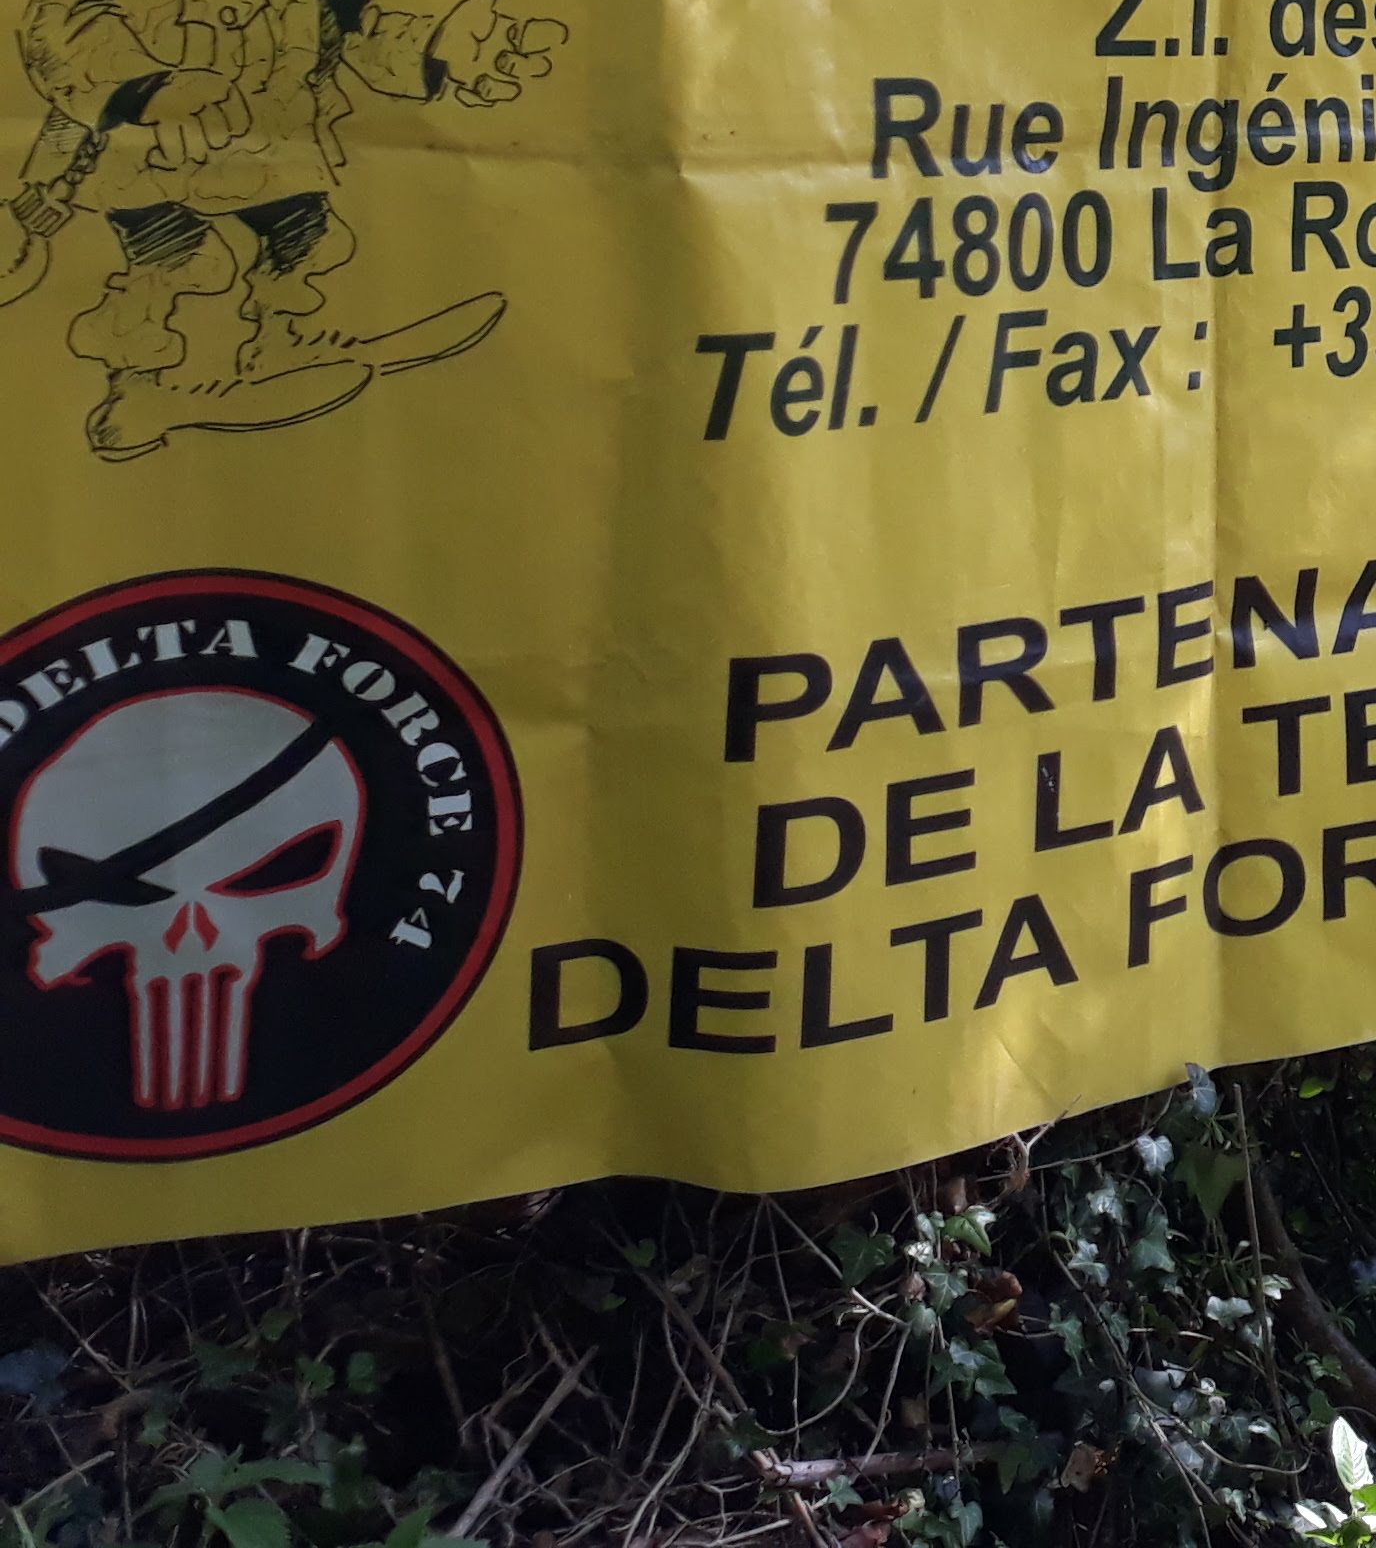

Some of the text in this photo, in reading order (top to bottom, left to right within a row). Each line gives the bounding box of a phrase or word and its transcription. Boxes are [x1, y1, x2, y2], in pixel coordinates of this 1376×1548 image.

[871, 78, 1063, 178] Rue
[826, 190, 1112, 304] 74800
[1152, 188, 1253, 280] La
[694, 325, 877, 442] Tél.
[985, 309, 1161, 413] Fax
[288, 633, 473, 837] FORCE
[388, 869, 465, 950] 74
[753, 769, 976, 909] DE
[1035, 726, 1205, 852] LA
[529, 894, 1078, 1054] DELTA
